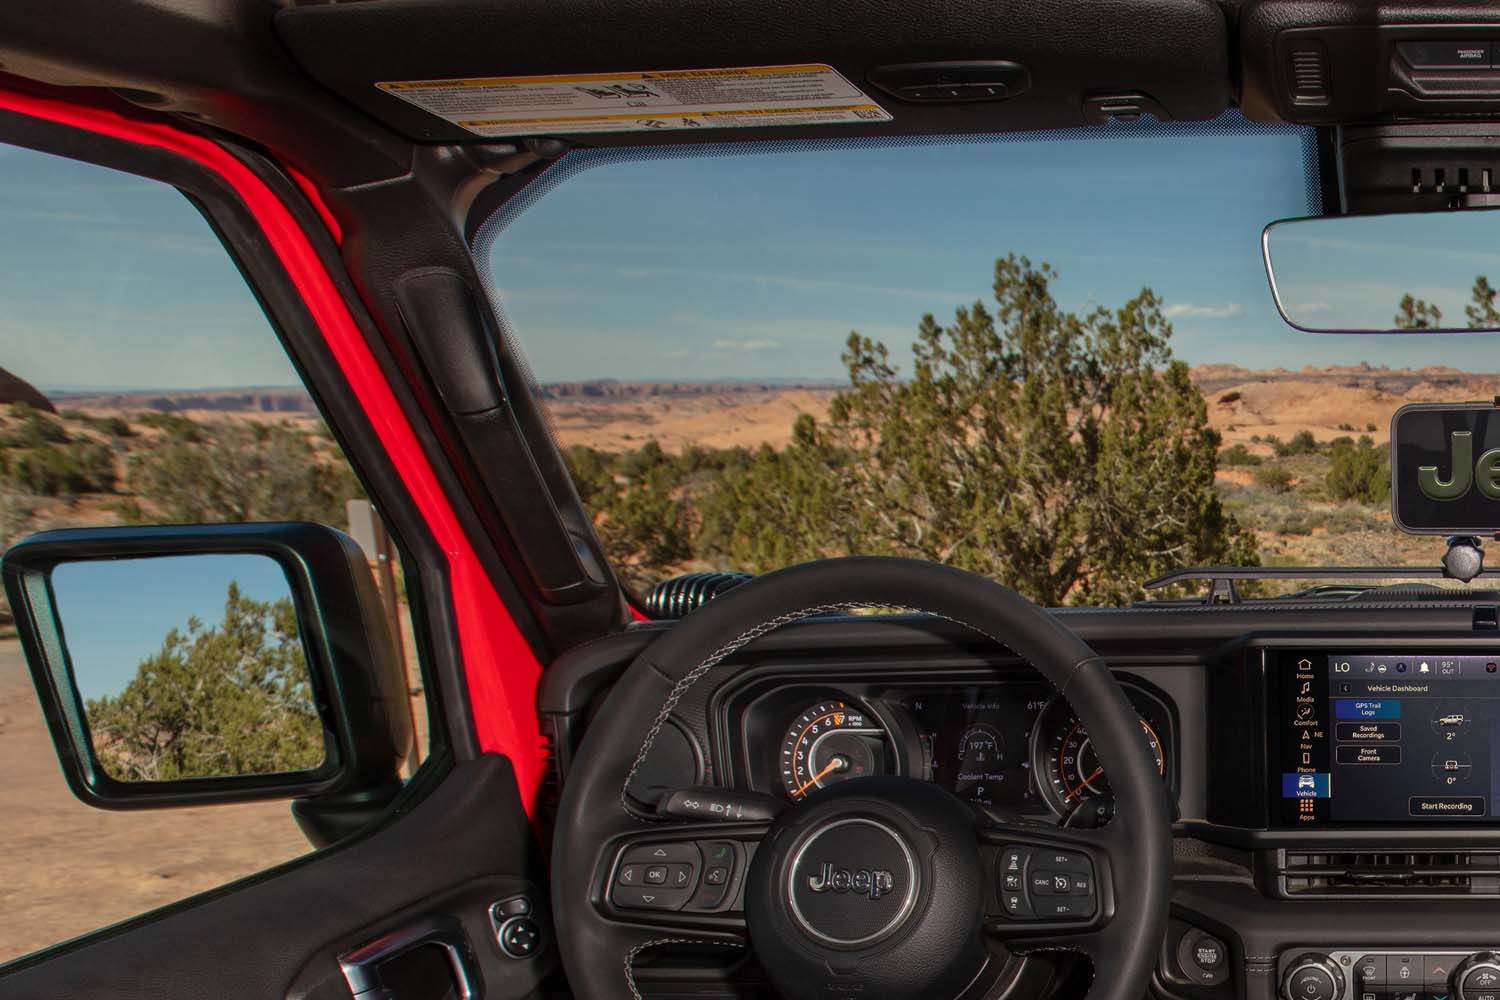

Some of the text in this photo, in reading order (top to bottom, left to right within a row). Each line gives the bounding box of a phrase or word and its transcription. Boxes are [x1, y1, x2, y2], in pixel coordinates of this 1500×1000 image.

[1335, 662, 1350, 673] LO
[824, 718, 832, 727] 6
[811, 725, 818, 734] 5
[1446, 732, 1456, 740] 2°
[802, 736, 808, 746] 4
[797, 751, 804, 760] 3
[1064, 756, 1074, 765] 20
[797, 766, 804, 775] 2
[958, 773, 1005, 783] Coolant Temp
[977, 786, 985, 796] P
[1438, 803, 1473, 812] Recording
[649, 871, 661, 879] OK
[807, 861, 895, 900] Jeep
